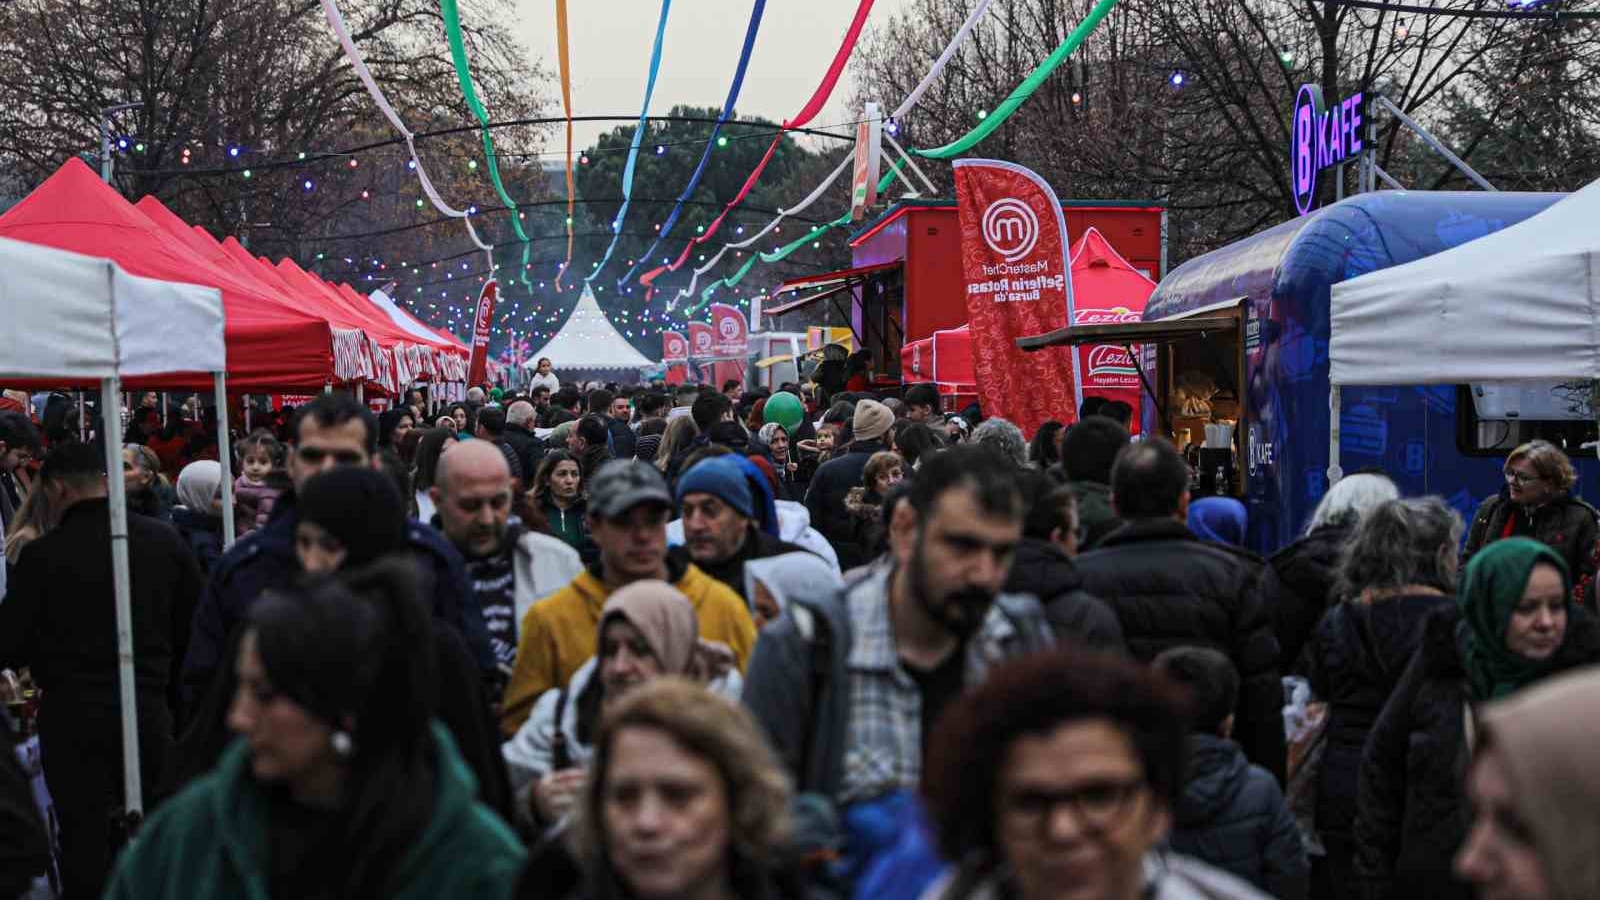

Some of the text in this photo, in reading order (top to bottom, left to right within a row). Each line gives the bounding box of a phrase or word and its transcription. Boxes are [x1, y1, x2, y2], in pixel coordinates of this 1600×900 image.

[1298, 92, 1363, 196] B KAFE
[1074, 308, 1142, 323] Lezita
